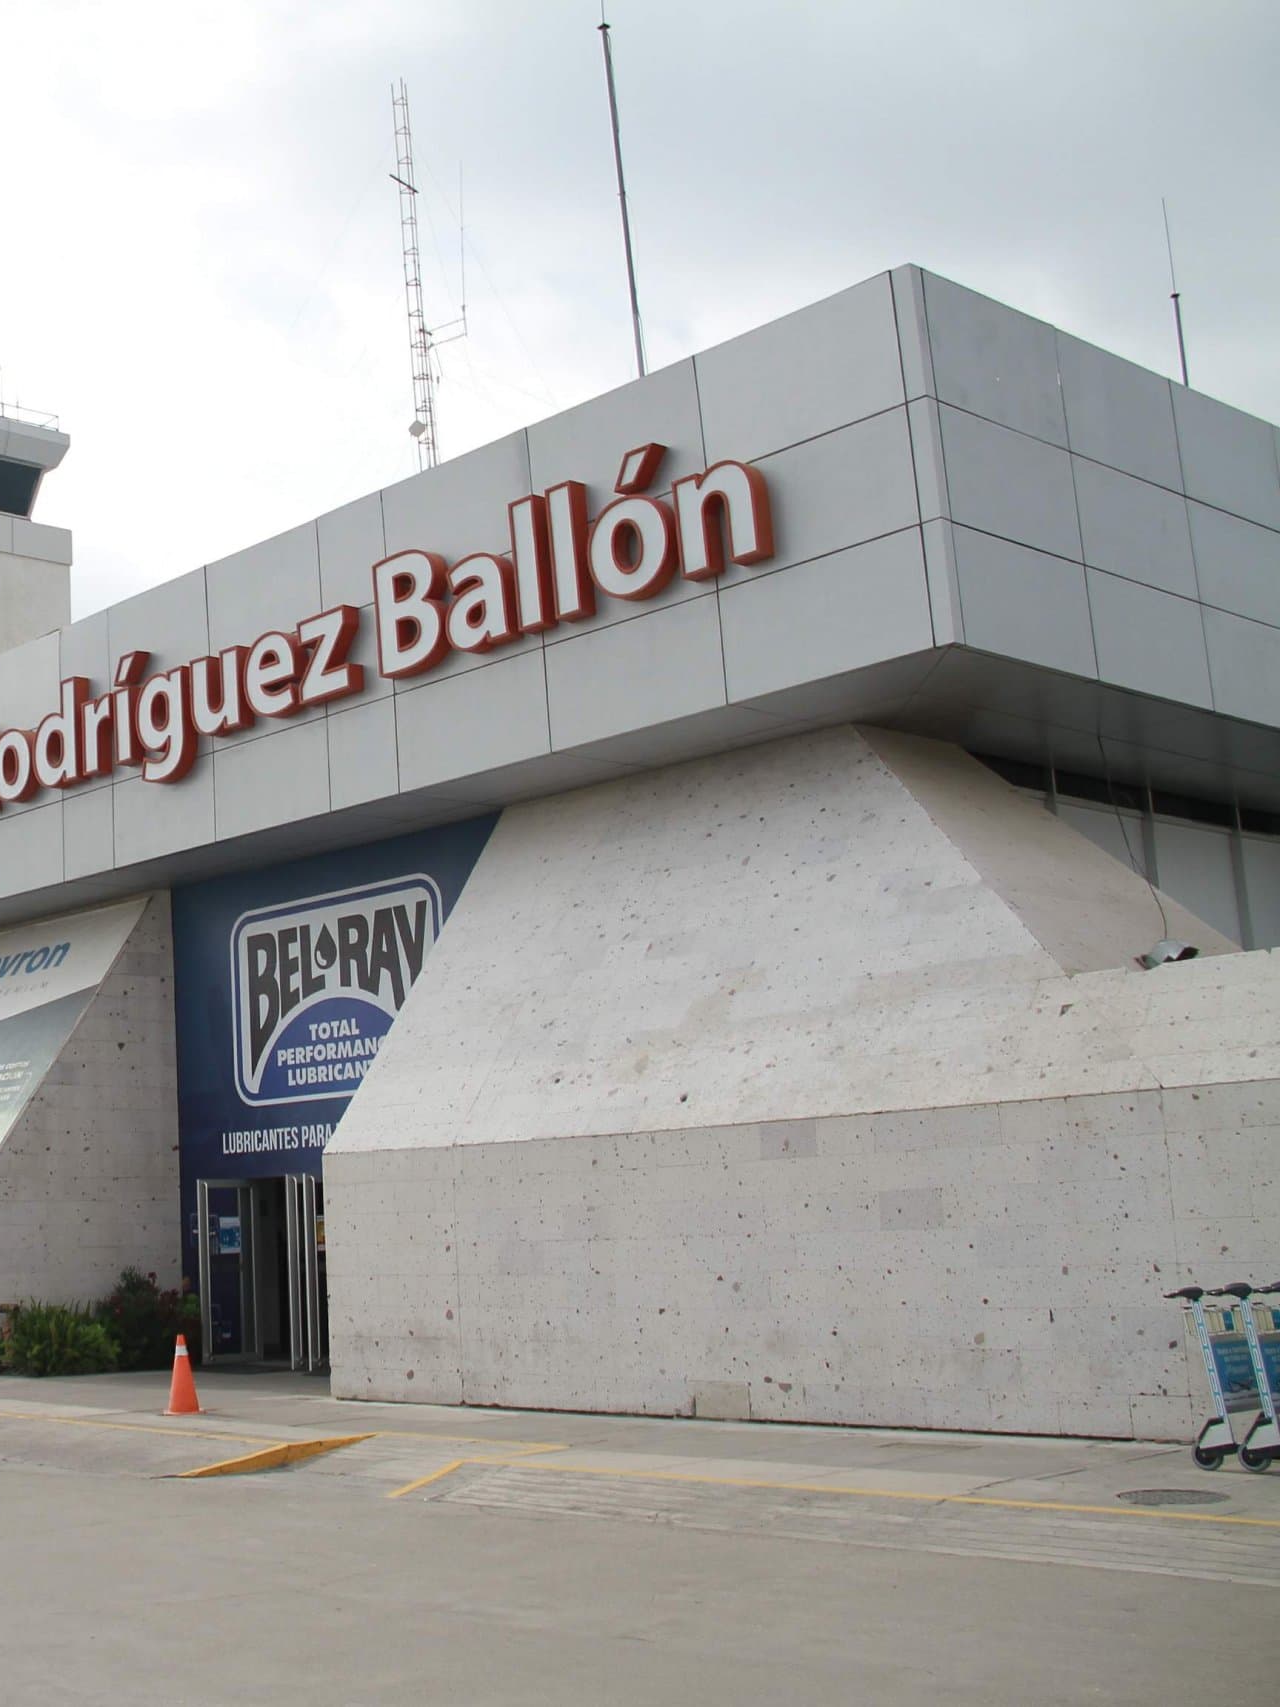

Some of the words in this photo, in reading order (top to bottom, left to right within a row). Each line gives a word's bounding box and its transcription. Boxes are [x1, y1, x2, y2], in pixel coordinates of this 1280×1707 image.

[373, 442, 775, 680] Ballón
[308, 1018, 360, 1041] TOTAL
[287, 1060, 372, 1087] LUBRICAN
[222, 1125, 299, 1155] LUBRICANTES
[301, 1123, 333, 1151] PARA
